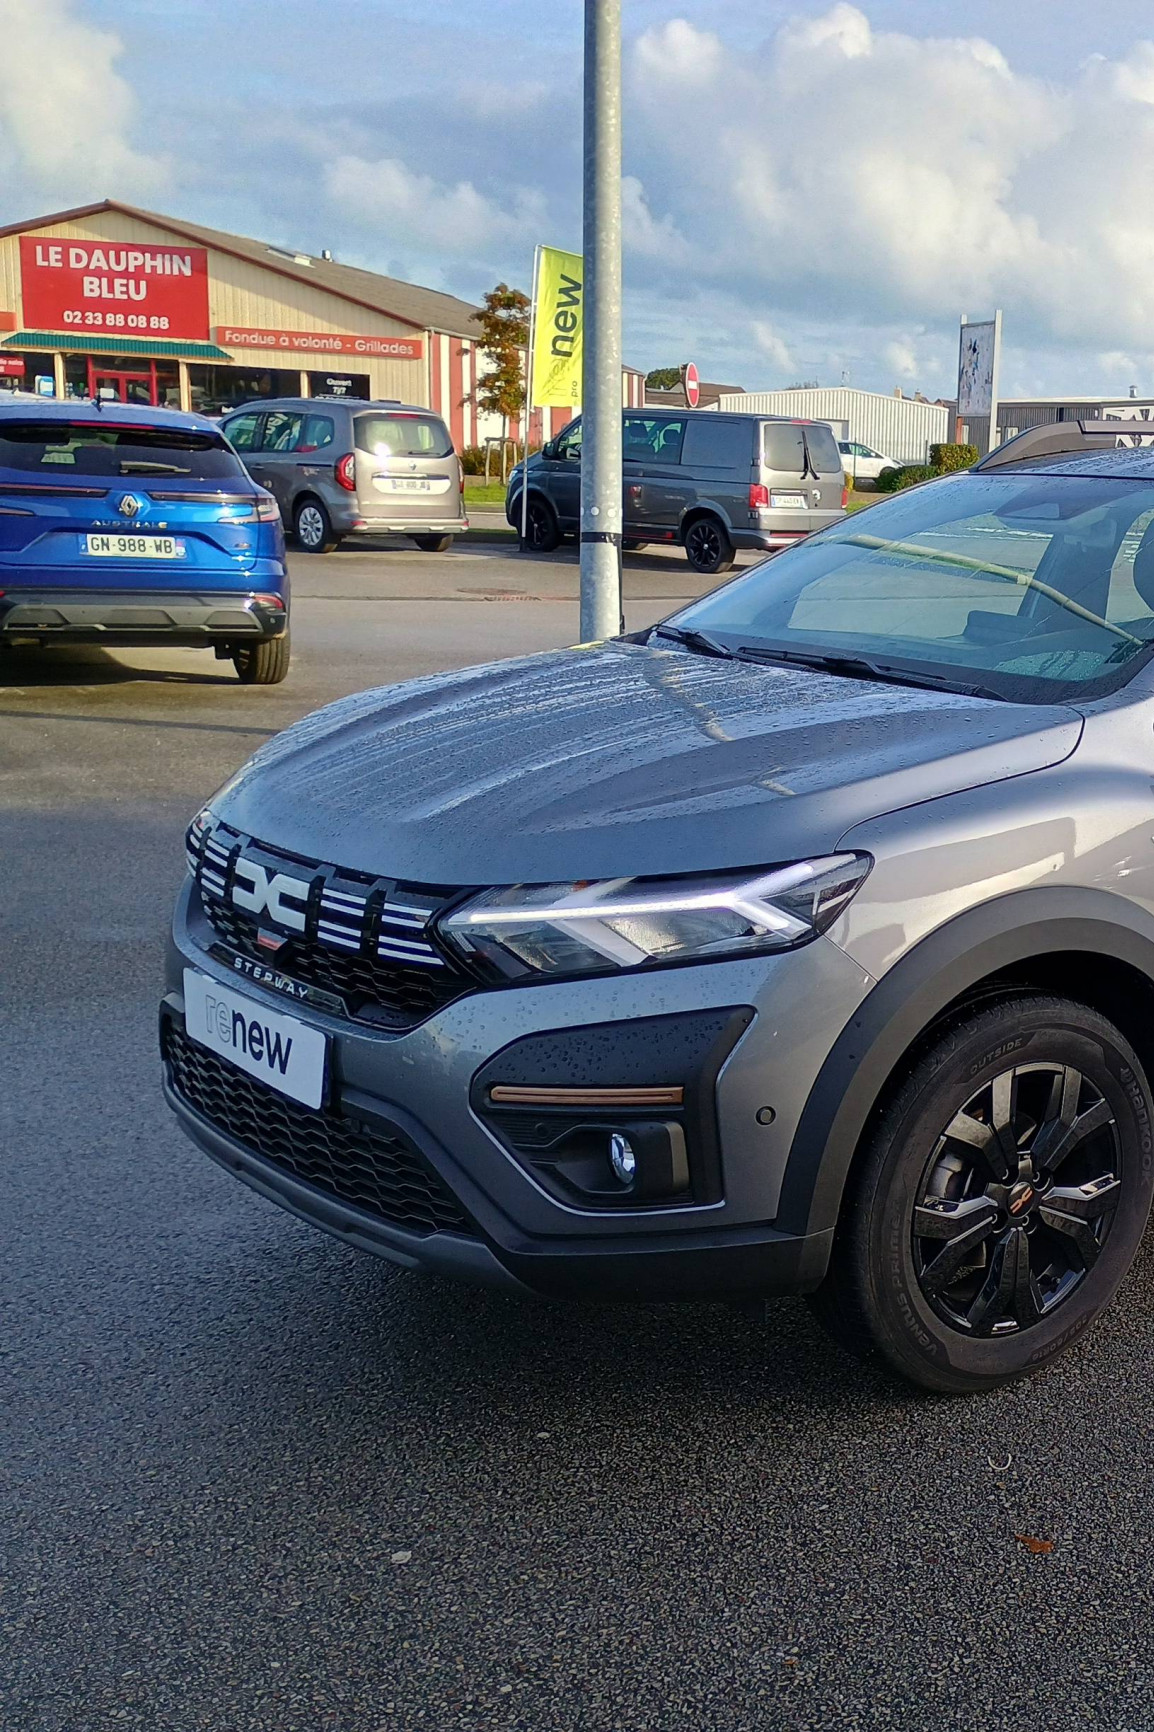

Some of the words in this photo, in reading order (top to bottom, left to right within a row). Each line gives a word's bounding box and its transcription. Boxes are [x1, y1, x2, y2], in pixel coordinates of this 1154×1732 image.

[36, 245, 63, 268] LE
[69, 247, 192, 276] DAUPHIN
[83, 276, 147, 301] BLEU
[63, 310, 83, 324] 02
[85, 312, 103, 325] 33
[105, 313, 125, 327] 88
[127, 315, 147, 328] 08
[149, 316, 169, 330] 88
[225, 330, 276, 345] Fondue
[279, 332, 290, 346] à
[292, 336, 343, 350] volonté
[354, 339, 414, 355] Grillades
[90, 536, 173, 554] GN-988-WB
[234, 957, 308, 998] STEPWAY
[206, 994, 293, 1075] renew
[970, 1037, 1023, 1075] OUTSIDE
